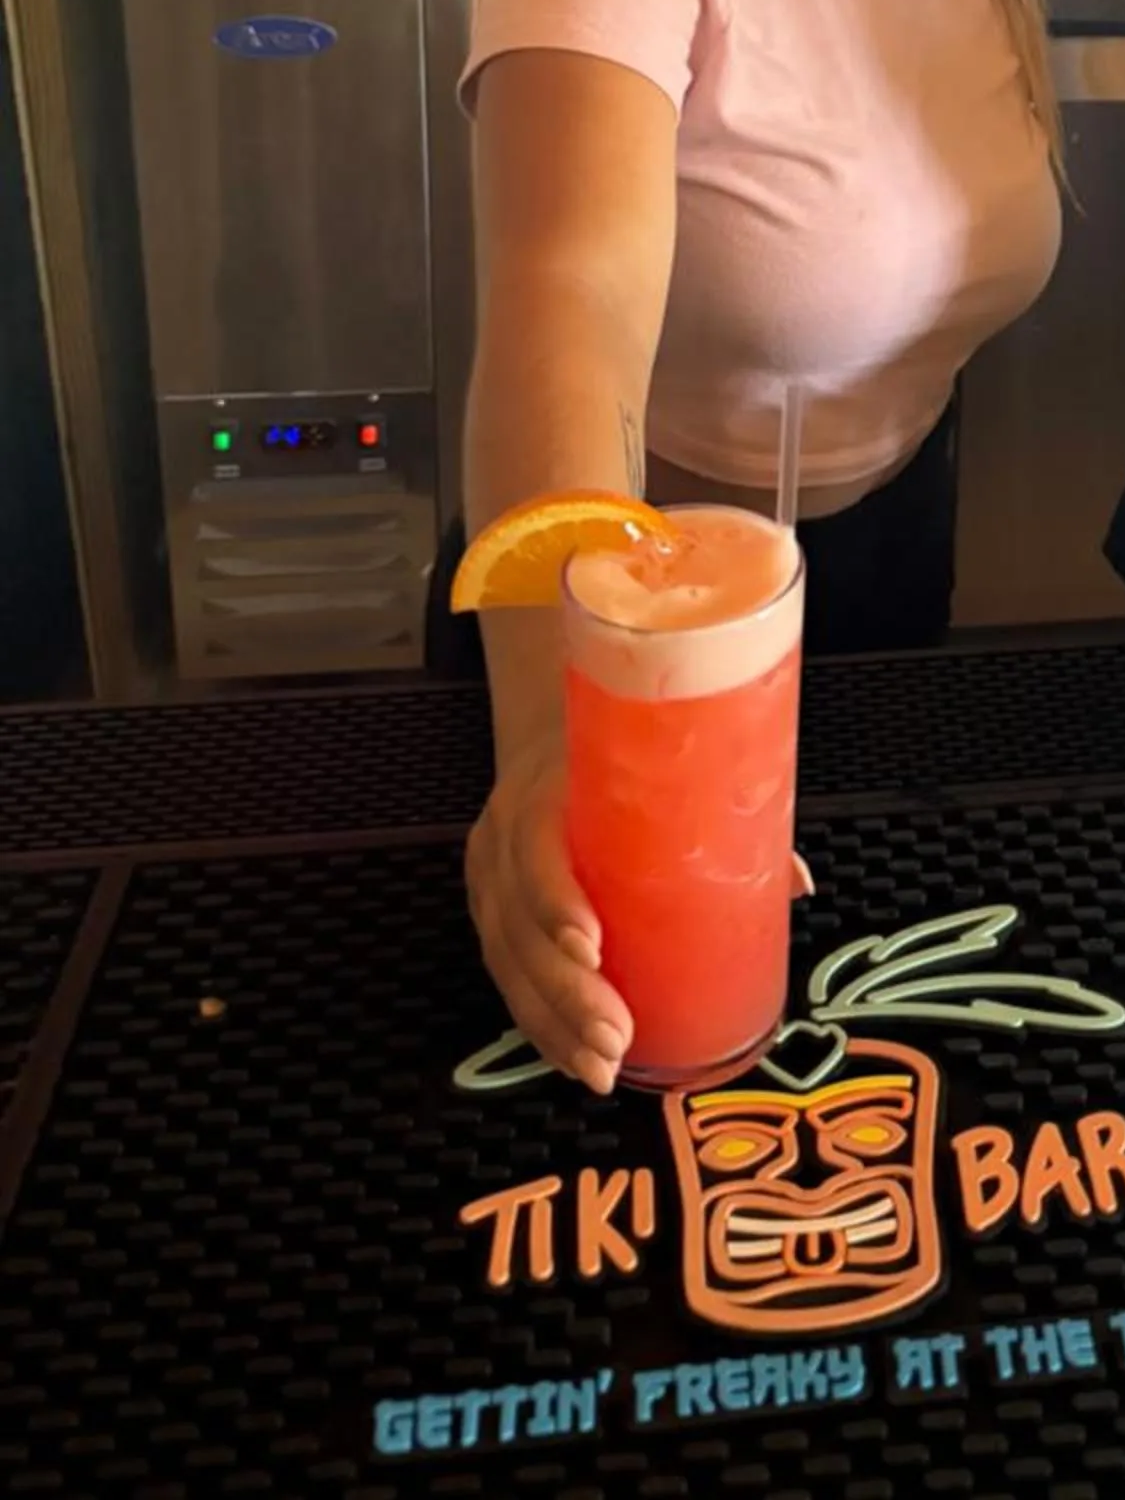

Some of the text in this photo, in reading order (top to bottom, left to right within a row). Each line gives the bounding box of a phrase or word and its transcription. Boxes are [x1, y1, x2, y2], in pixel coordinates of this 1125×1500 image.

[459, 1167, 655, 1287] TIKI
[373, 1368, 614, 1454] GETTIN'
[632, 1343, 866, 1423] FREAKY
[893, 1332, 965, 1389] AT
[983, 1317, 1097, 1380] THE
